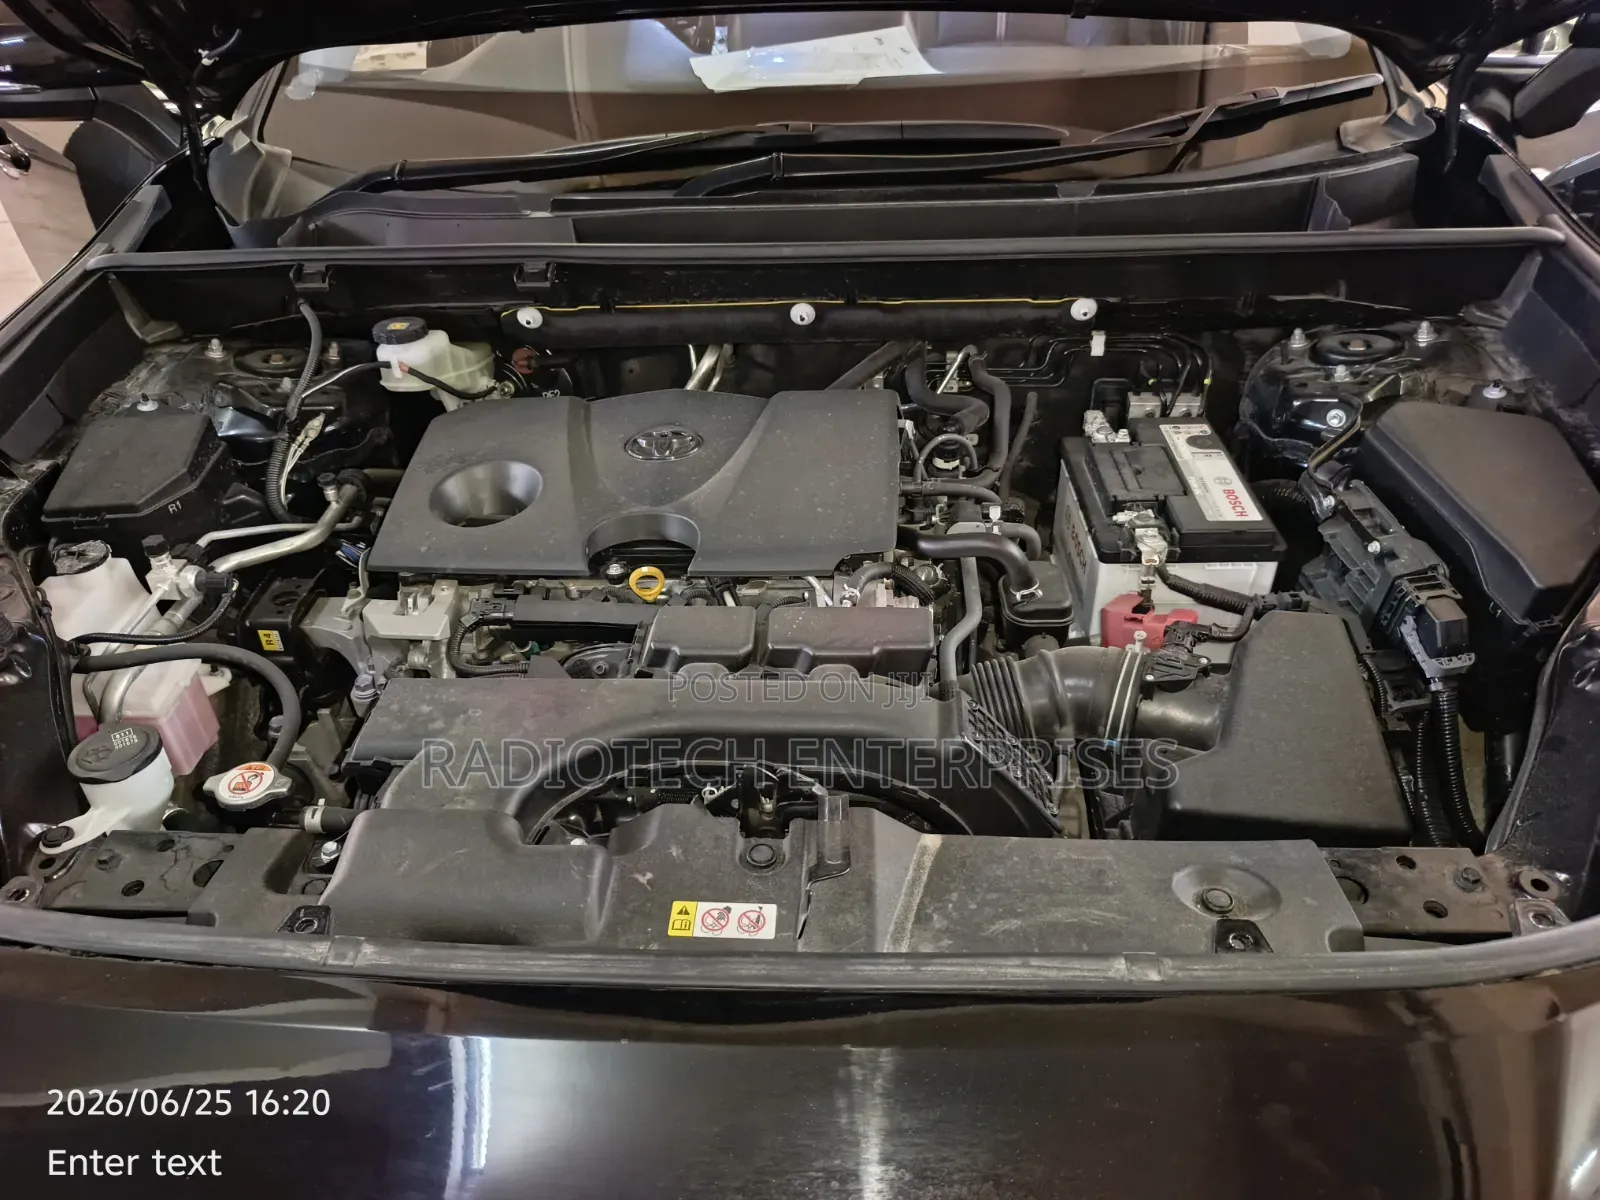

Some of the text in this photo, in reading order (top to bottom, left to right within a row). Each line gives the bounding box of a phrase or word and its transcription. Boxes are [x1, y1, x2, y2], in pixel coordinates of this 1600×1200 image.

[168, 500, 182, 514] R1
[1222, 489, 1249, 517] BOSCH
[263, 633, 275, 645] R4
